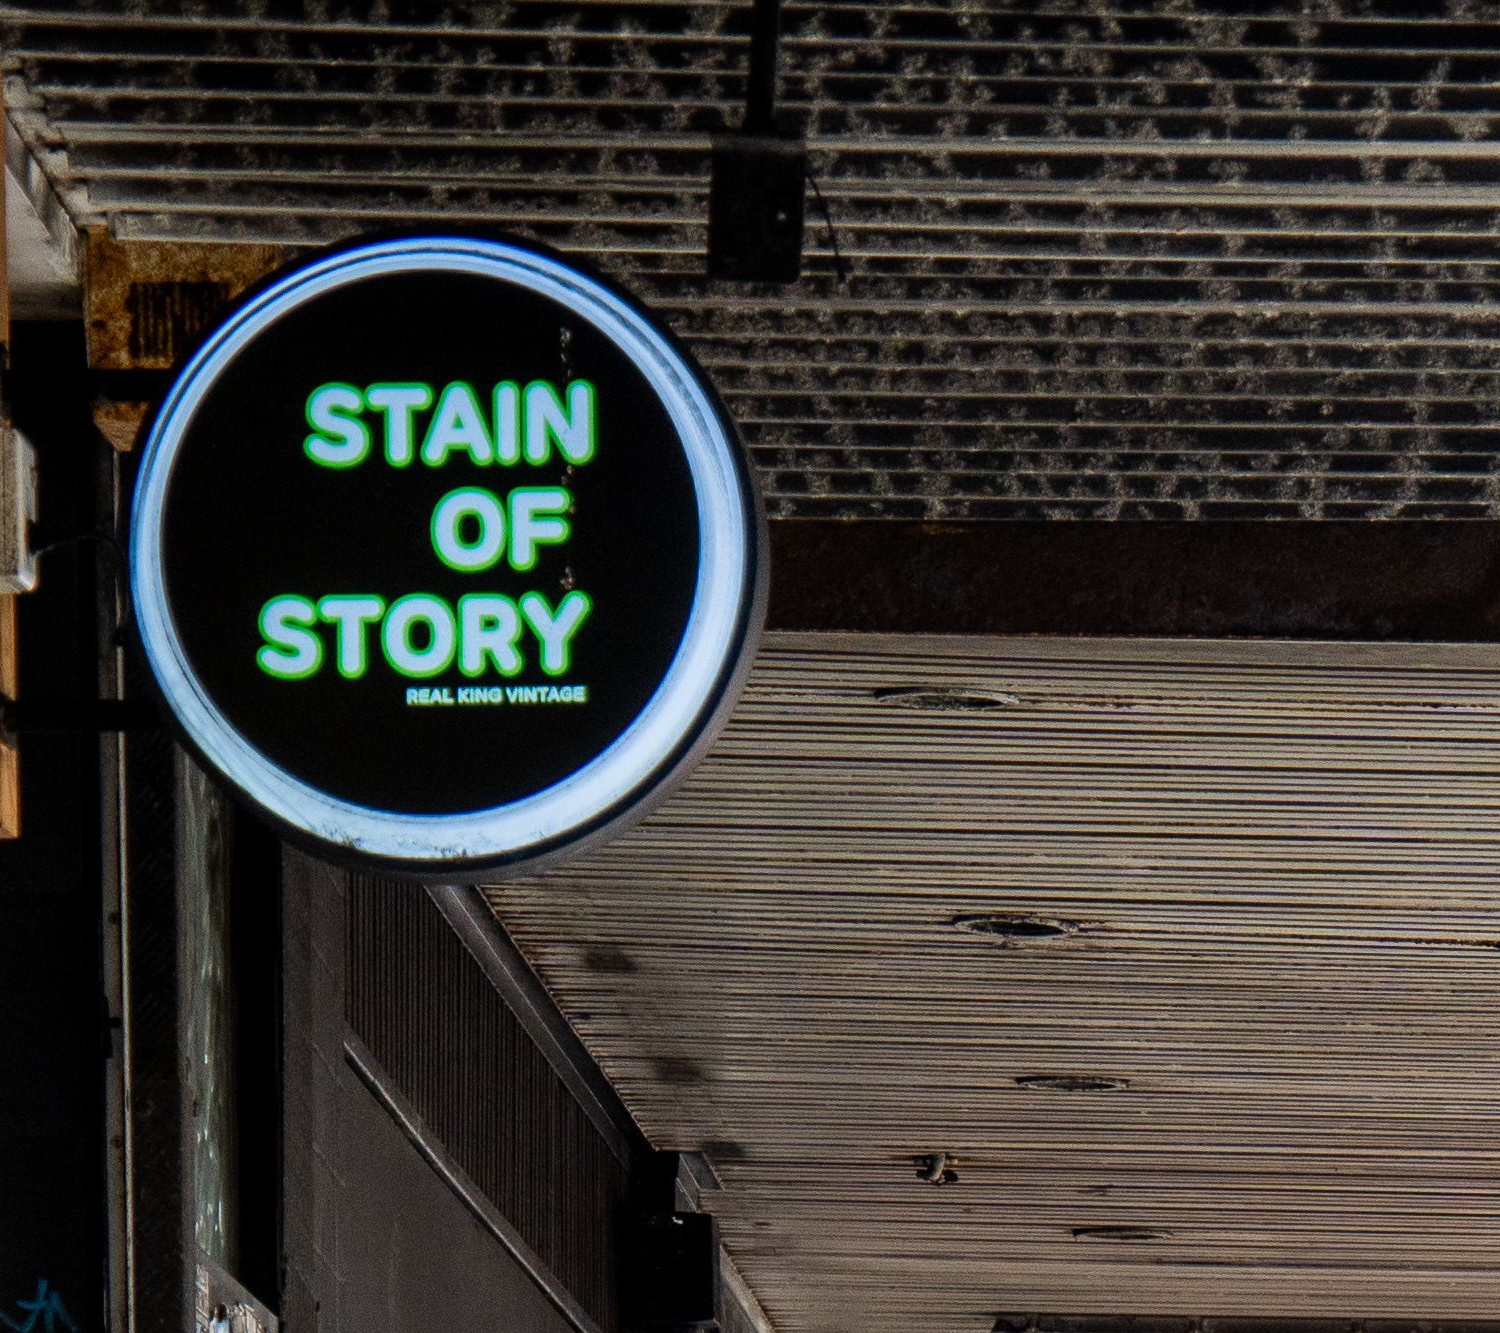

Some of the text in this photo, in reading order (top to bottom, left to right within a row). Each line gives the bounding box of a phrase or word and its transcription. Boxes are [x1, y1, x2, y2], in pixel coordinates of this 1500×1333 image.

[304, 379, 596, 469] STAIN
[431, 486, 570, 571] OF
[257, 591, 592, 680] STORY
[406, 685, 586, 705] REAL KING VINTAGE
